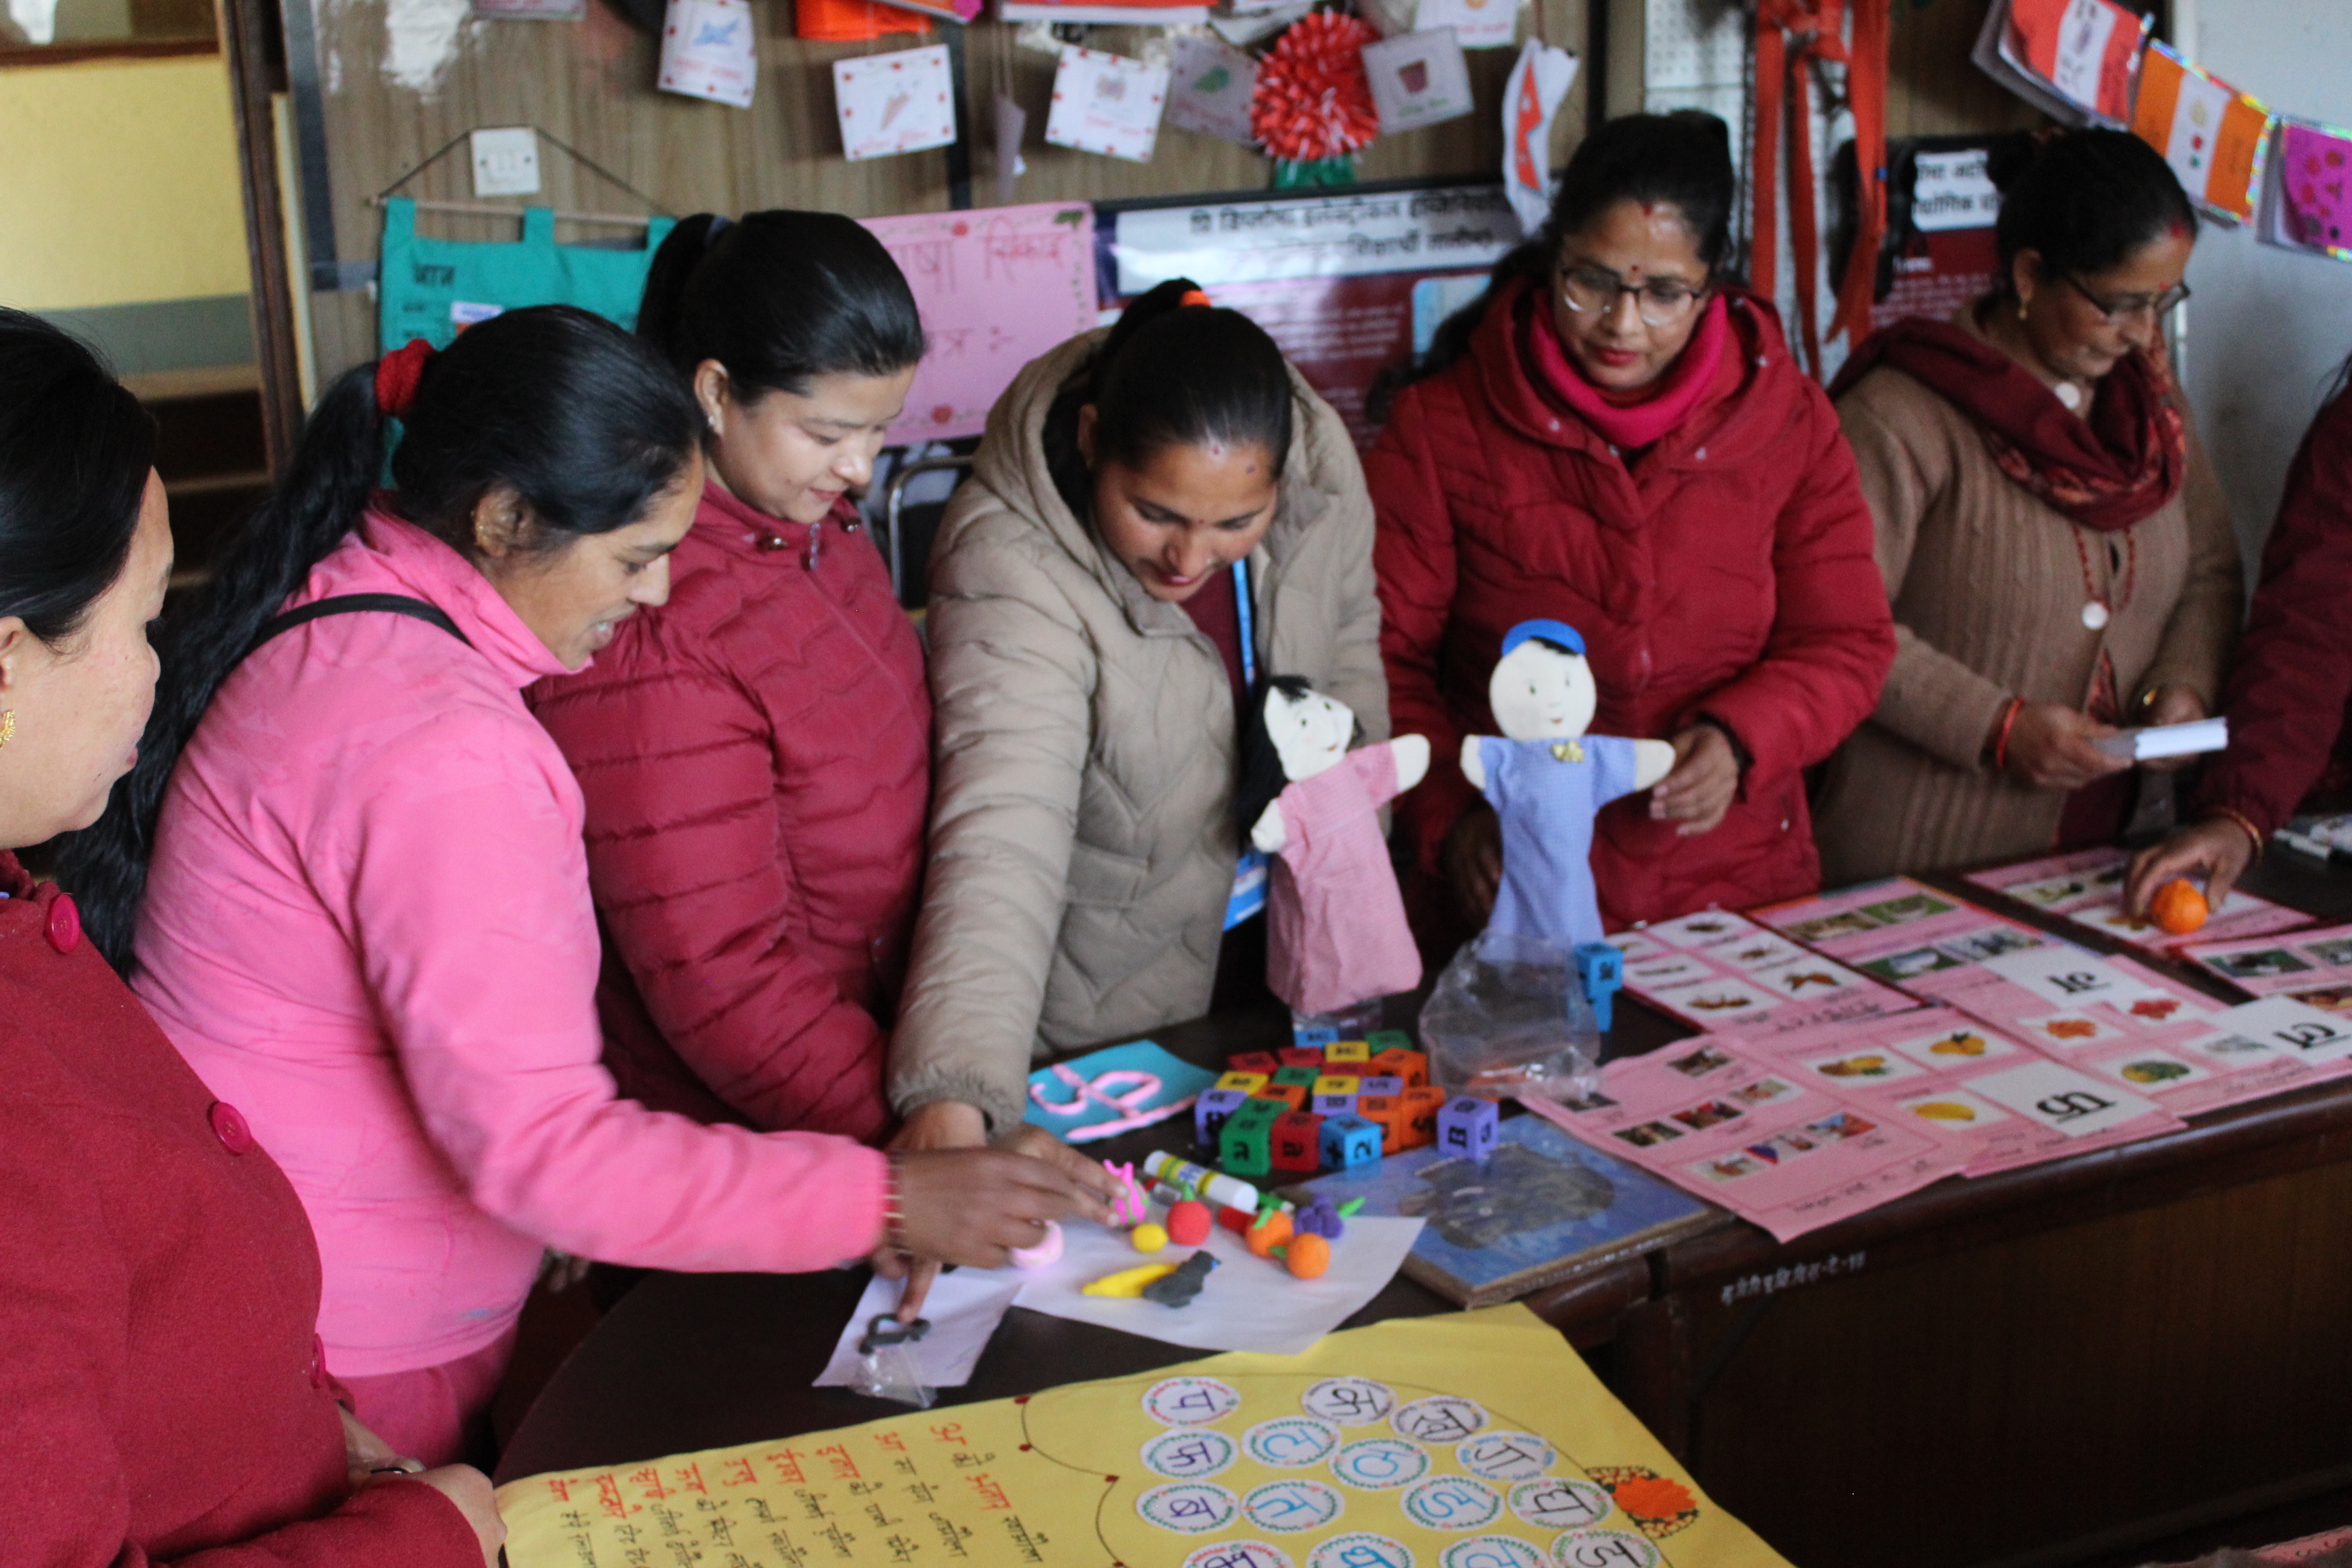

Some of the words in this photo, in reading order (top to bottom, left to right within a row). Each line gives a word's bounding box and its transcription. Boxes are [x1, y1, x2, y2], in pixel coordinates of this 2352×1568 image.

[1170, 1389, 1215, 1412] प
[1324, 1387, 1379, 1416] क
[929, 1422, 968, 1446] अ
[1411, 1407, 1472, 1440] ख
[874, 1431, 906, 1451] आ
[1166, 1441, 1212, 1467] फ
[1263, 1428, 1323, 1458] ट
[1353, 1448, 1412, 1479] ठ
[1475, 1443, 1536, 1471] ग
[1256, 1489, 1322, 1518] त
[1419, 1486, 1487, 1518] ड
[1531, 1484, 1595, 1515] घ
